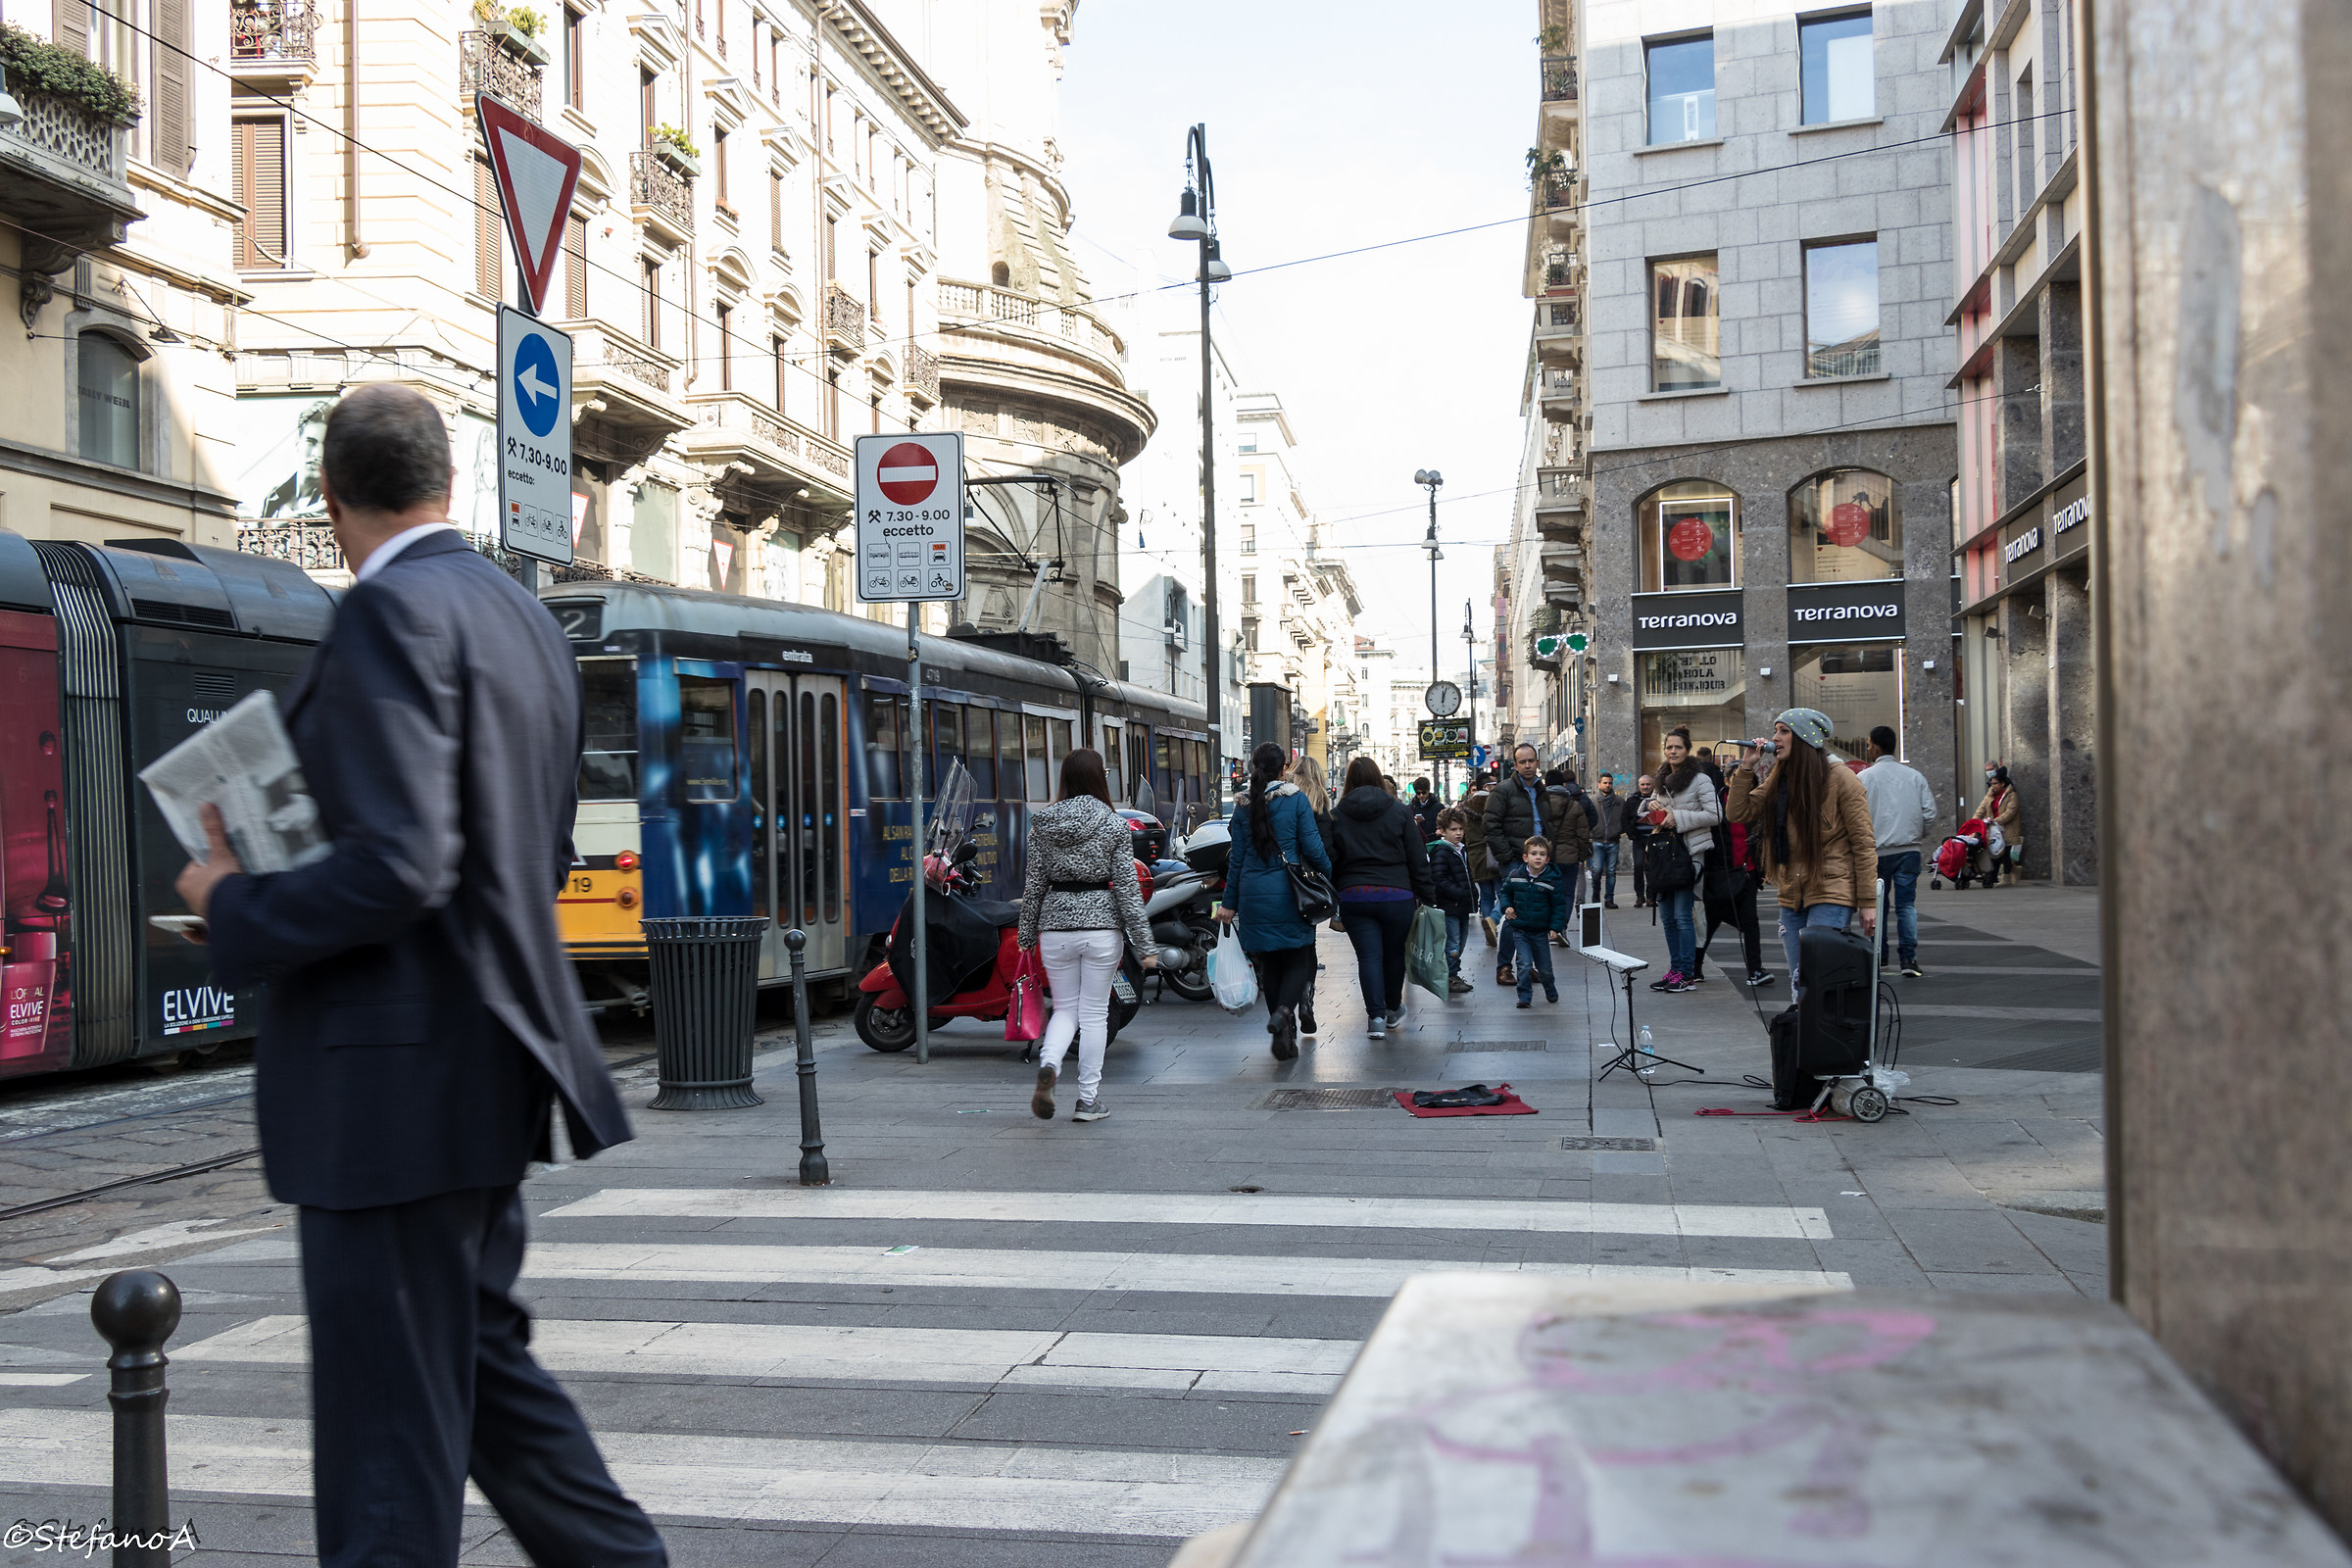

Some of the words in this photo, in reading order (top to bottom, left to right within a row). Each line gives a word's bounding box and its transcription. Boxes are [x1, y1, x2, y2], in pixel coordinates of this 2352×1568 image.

[508, 469, 535, 485] eccetto:
[883, 524, 934, 537] eccetto
[1638, 612, 1738, 628] Terranova
[1794, 604, 1898, 621] Terranova
[562, 609, 587, 637] 2
[1684, 668, 1715, 678] HOLA
[10, 1001, 44, 1019] ELVIVE
[164, 986, 234, 1022] ELVIVE
